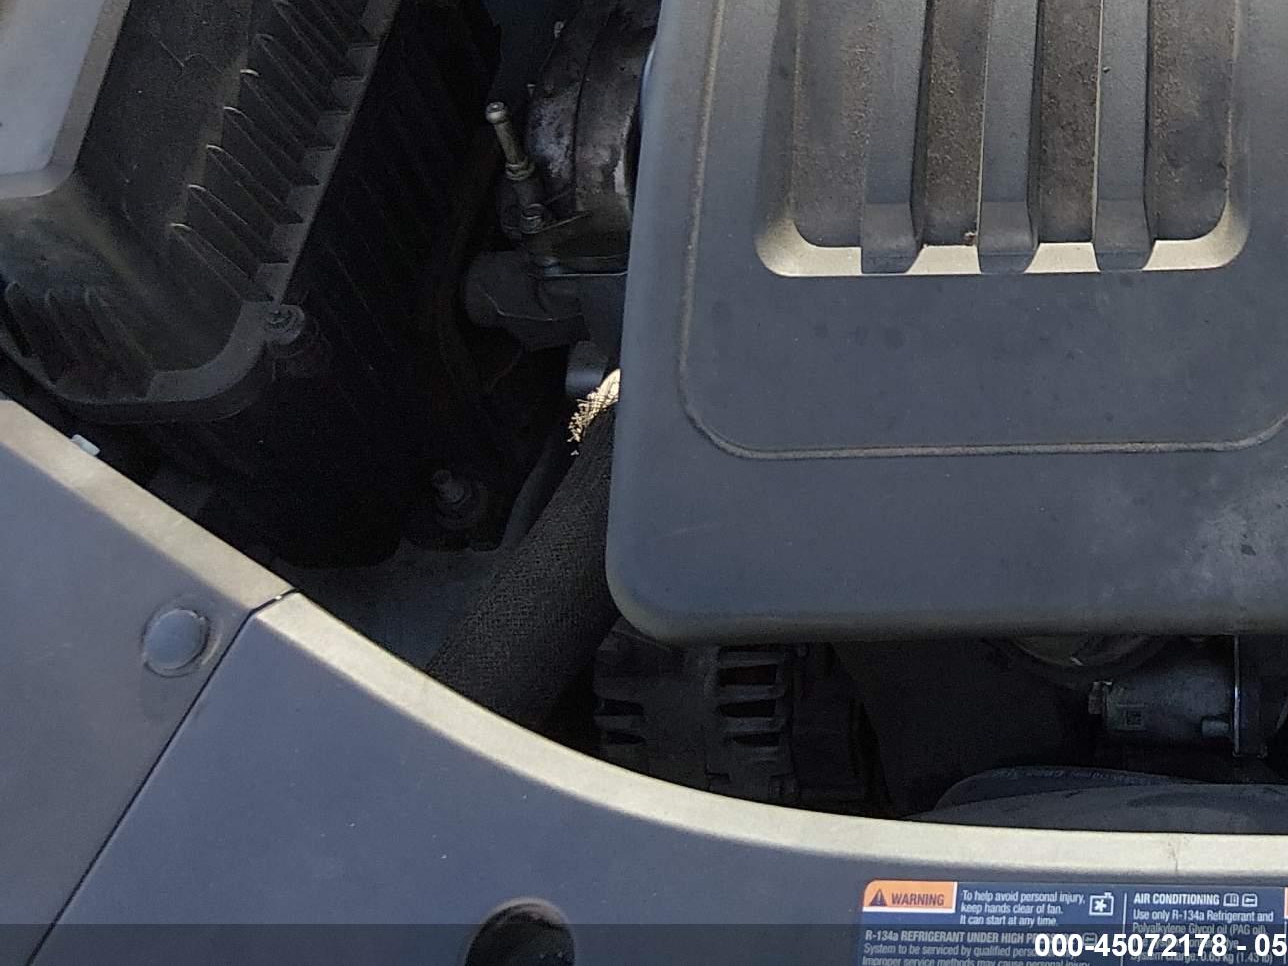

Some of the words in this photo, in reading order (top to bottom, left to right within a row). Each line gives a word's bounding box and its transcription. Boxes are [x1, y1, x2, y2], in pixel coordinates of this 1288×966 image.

[891, 893, 944, 906] WARNING
[962, 889, 973, 901] To
[974, 890, 992, 903] help
[994, 891, 1019, 902] avoid
[1020, 891, 1058, 905] personal
[1060, 892, 1086, 905] injury,
[1133, 893, 1151, 904] AIR
[1152, 893, 1220, 905] CONDITIONING
[961, 903, 981, 914] keep
[984, 903, 1011, 914] hands
[1013, 903, 1034, 914] clear
[1036, 904, 1046, 914] of
[1046, 904, 1063, 914] fan.
[960, 915, 967, 925] It
[968, 916, 984, 925] can
[985, 915, 1006, 926] start
[1007, 915, 1018, 926] at
[1019, 917, 1035, 927] any
[1133, 909, 1150, 920] Use
[1151, 909, 1170, 922] only
[1171, 909, 1205, 921] R-134a
[1206, 910, 1255, 923] Refrigerant
[1257, 911, 1274, 922] and
[1188, 923, 1216, 935] Glycol
[1216, 924, 1228, 934] oil
[1229, 923, 1251, 936] (PAG
[865, 929, 899, 942] R-134a
[900, 930, 966, 943] REFRIGERANT
[966, 932, 999, 944] UNDER
[1001, 932, 1024, 944] HIGH
[863, 942, 896, 956] System
[898, 944, 908, 954] to
[909, 944, 921, 955] be
[922, 945, 960, 956] serviced
[961, 945, 972, 957] by
[973, 946, 1011, 958] qualified
